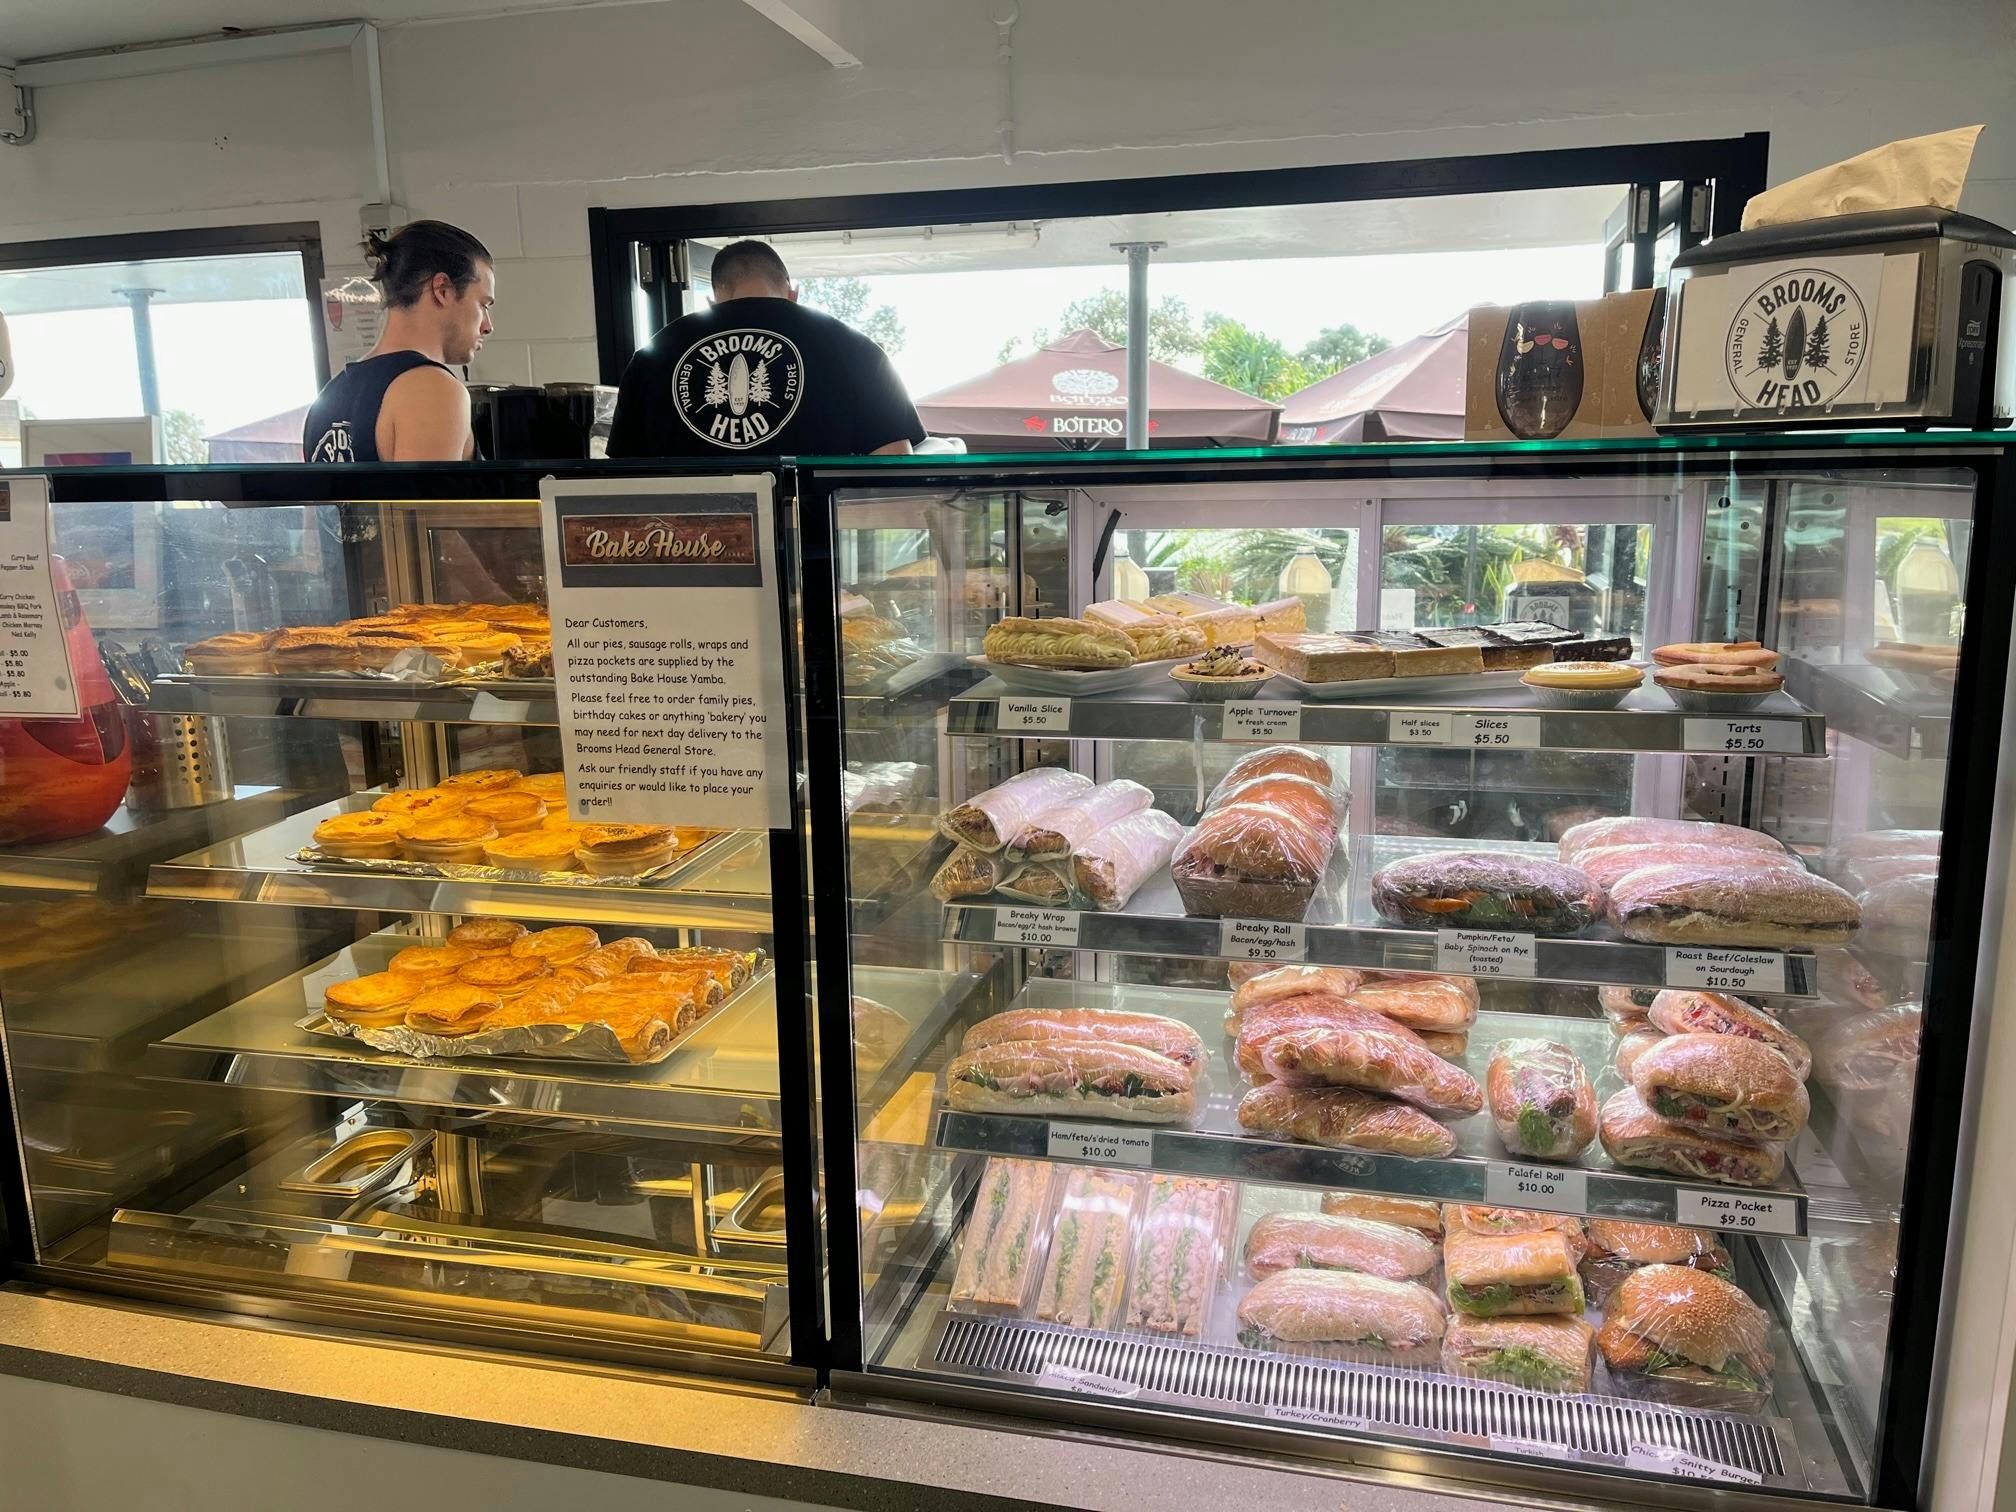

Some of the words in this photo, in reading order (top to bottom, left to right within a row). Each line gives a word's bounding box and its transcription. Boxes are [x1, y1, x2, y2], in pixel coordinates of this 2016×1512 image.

[1757, 278, 1846, 315] BROOMS
[700, 335, 782, 362] BROOMS
[1732, 318, 1749, 374] GENERAL
[1844, 322, 1860, 366] STORE
[679, 363, 693, 412] GENERAL
[784, 363, 796, 400] STORE
[1756, 379, 1821, 408] HEAD
[710, 412, 769, 442] HEAD
[1053, 416, 1123, 436] BOTERO
[586, 529, 650, 558] Bake
[645, 529, 726, 558] House
[565, 618, 589, 628] Dear
[593, 618, 648, 629] Customers,
[567, 639, 580, 649] All
[583, 641, 600, 649] our
[603, 639, 626, 650] pies,
[628, 641, 667, 651] sausage
[670, 639, 695, 650] rolls,
[698, 641, 727, 651] wraps
[730, 639, 749, 650] and
[568, 657, 594, 667] pizza
[597, 656, 636, 667] pockets
[638, 658, 655, 666] are
[657, 657, 698, 668] supplied
[701, 657, 713, 669] by
[717, 657, 734, 667] the
[570, 673, 628, 685] outstanding
[631, 673, 654, 684] Bake
[657, 673, 688, 684] House
[690, 673, 726, 684] Yamba.
[571, 693, 602, 703] Please
[606, 693, 626, 703] feel
[628, 693, 651, 704] free
[654, 694, 664, 704] to
[667, 694, 695, 704] order
[699, 694, 729, 707] family
[732, 695, 756, 706] pies,
[1008, 704, 1037, 712] Vanilla
[1041, 704, 1062, 713] Slice
[1229, 708, 1253, 716] Apple
[1258, 708, 1297, 716] Turnover
[573, 710, 616, 722] birthday
[619, 710, 646, 721] cakes
[649, 713, 660, 721] or
[663, 711, 705, 723] anything
[708, 712, 746, 725] 'bakery'
[749, 714, 767, 724] you
[1023, 716, 1046, 724] $5.50
[1474, 719, 1509, 729] Slices
[575, 728, 594, 739] may
[597, 727, 620, 737] need
[623, 727, 639, 738] for
[642, 728, 664, 738] next
[667, 728, 685, 740] day
[688, 729, 728, 741] delivery
[731, 730, 742, 740] to
[745, 730, 763, 740] the
[1727, 723, 1762, 733] Tarts
[1474, 733, 1510, 745] $5.50
[1725, 738, 1764, 750] $5.50
[577, 743, 612, 753] Brooms
[615, 744, 640, 754] Head
[643, 744, 681, 755] General
[685, 746, 716, 756] Store.
[579, 764, 596, 773] Ask
[618, 763, 657, 777] friendly
[660, 765, 685, 775] staff
[689, 765, 698, 776] if
[700, 768, 718, 778] you
[721, 767, 743, 777] have
[746, 769, 763, 780] any
[579, 781, 622, 792] enquiries
[625, 783, 636, 791] or
[639, 781, 666, 792] would
[669, 781, 686, 792] like
[690, 783, 700, 793] to
[703, 783, 729, 795] place
[731, 786, 754, 796] your
[580, 796, 613, 807] order!!
[1010, 910, 1039, 922] Breaky
[1042, 912, 1066, 923] Wrap
[1236, 922, 1269, 935] Breaky
[1273, 925, 1291, 934] Roll
[1020, 931, 1052, 942] $10.00
[1230, 935, 1296, 947] Bacon/egg/hash
[1248, 948, 1276, 958] $9.50
[1444, 942, 1464, 952] Baby
[1467, 944, 1498, 953] Spinach
[1513, 947, 1528, 956] Rye
[1469, 954, 1503, 964] (toasted)
[1675, 951, 1702, 960] Roast
[1706, 952, 1775, 964] Beef/Coleslaw
[1472, 965, 1500, 973] $10.50
[1709, 965, 1755, 976] Sourdough
[1706, 976, 1746, 988] $10.50
[1122, 1138, 1150, 1147] tomato
[1082, 1146, 1117, 1157] $10.00
[1508, 1167, 1542, 1179] Falafel
[1546, 1171, 1564, 1181] Roll
[1518, 1182, 1554, 1194] $10.00
[1701, 1196, 1730, 1209] Pizza
[1734, 1200, 1773, 1213] Pocket
[1720, 1213, 1756, 1226] $9.50
[1275, 1408, 1361, 1427] Turkey/Cranberry
[1515, 1447, 1544, 1457] Turkish
[1679, 1458, 1716, 1474] Snitty
